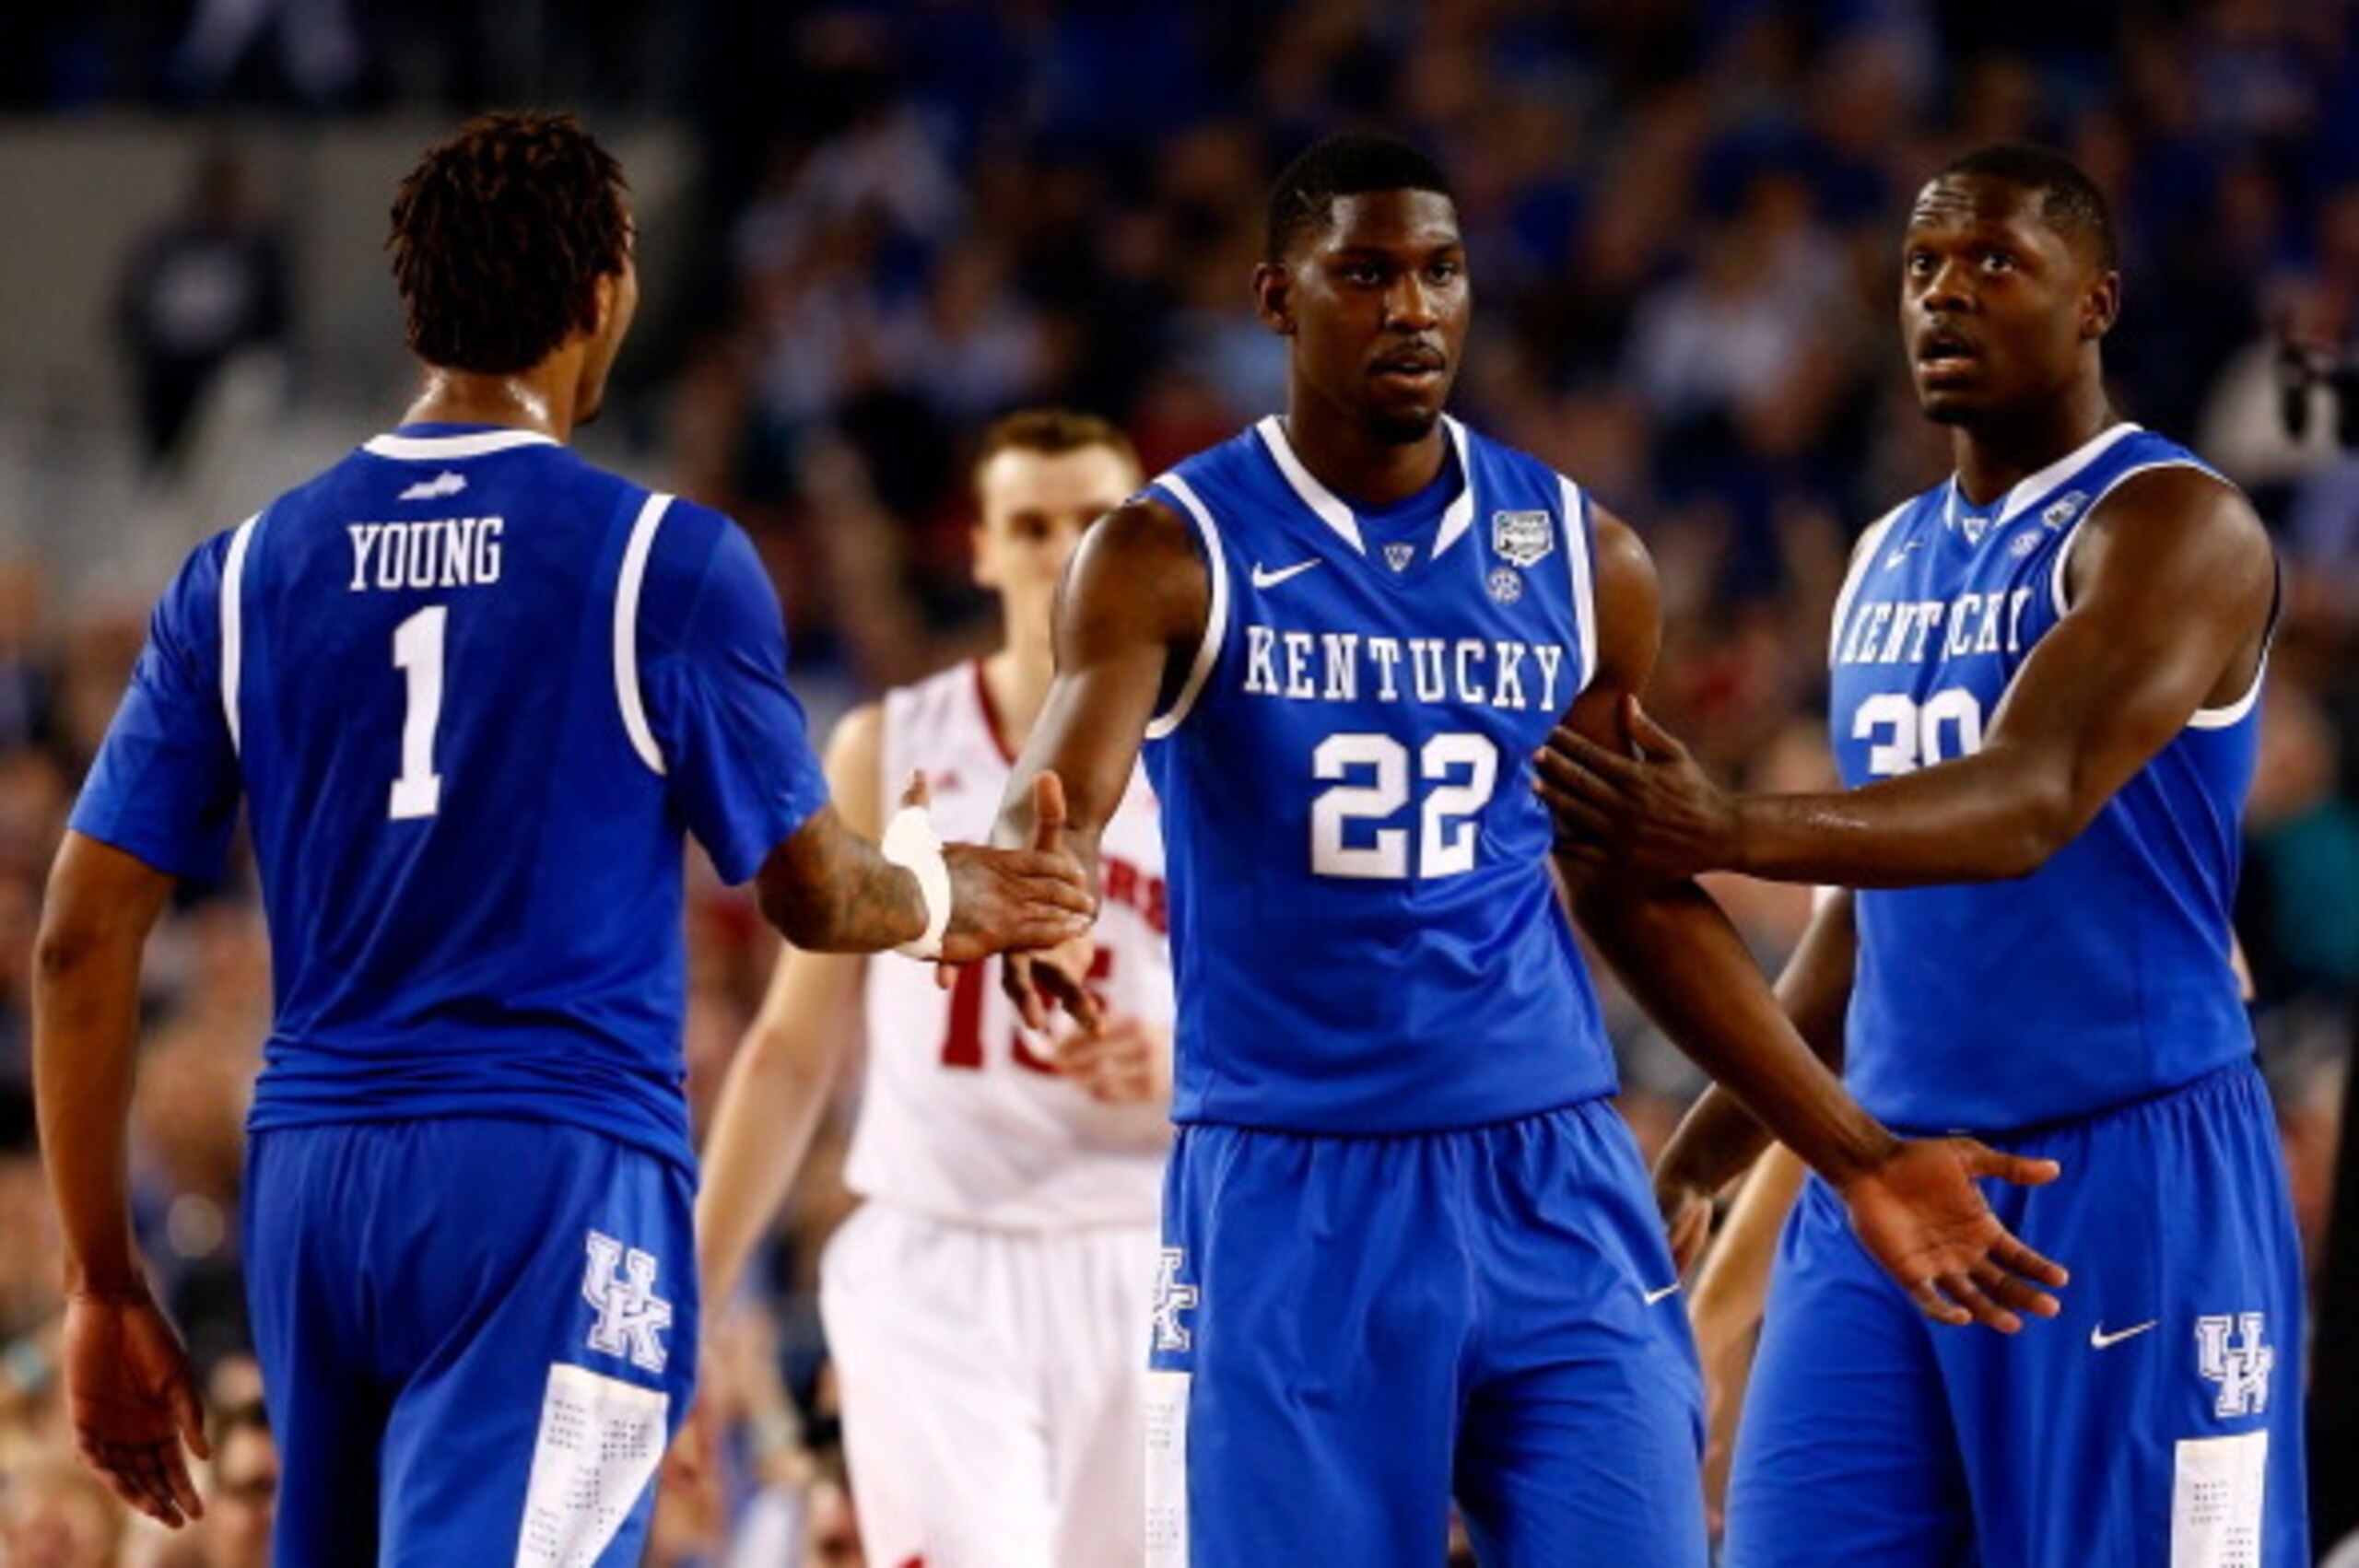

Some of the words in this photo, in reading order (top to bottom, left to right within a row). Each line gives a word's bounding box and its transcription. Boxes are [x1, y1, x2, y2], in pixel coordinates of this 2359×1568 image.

[347, 517, 504, 591] YOUNG
[390, 605, 447, 820] 1
[1244, 626, 1563, 711] KENTUCKY
[1311, 733, 1499, 879] 22
